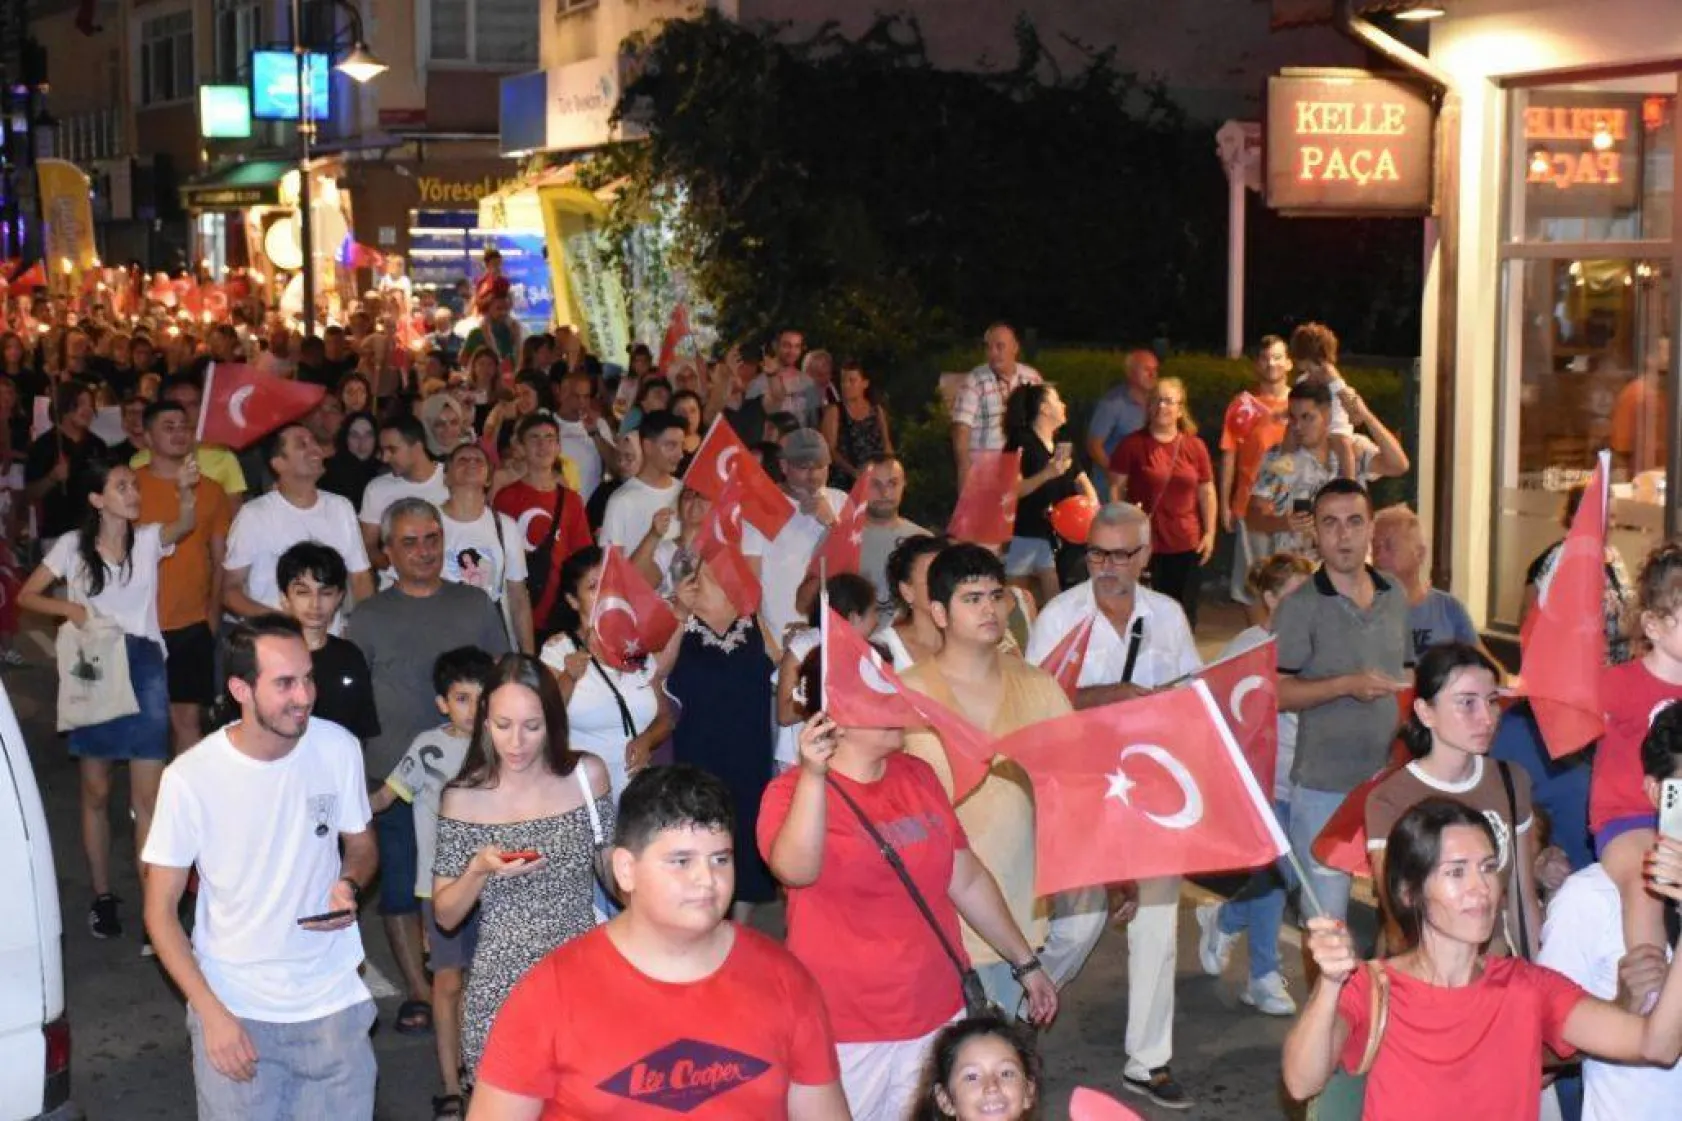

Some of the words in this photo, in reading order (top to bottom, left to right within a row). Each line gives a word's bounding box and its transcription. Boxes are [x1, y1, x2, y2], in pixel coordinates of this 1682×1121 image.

[1295, 101, 1406, 135] KELLE
[1299, 146, 1400, 186] PAÇA
[418, 175, 491, 202] Yöresel
[630, 1063, 666, 1095] Lee
[670, 1059, 752, 1091] Cooper
